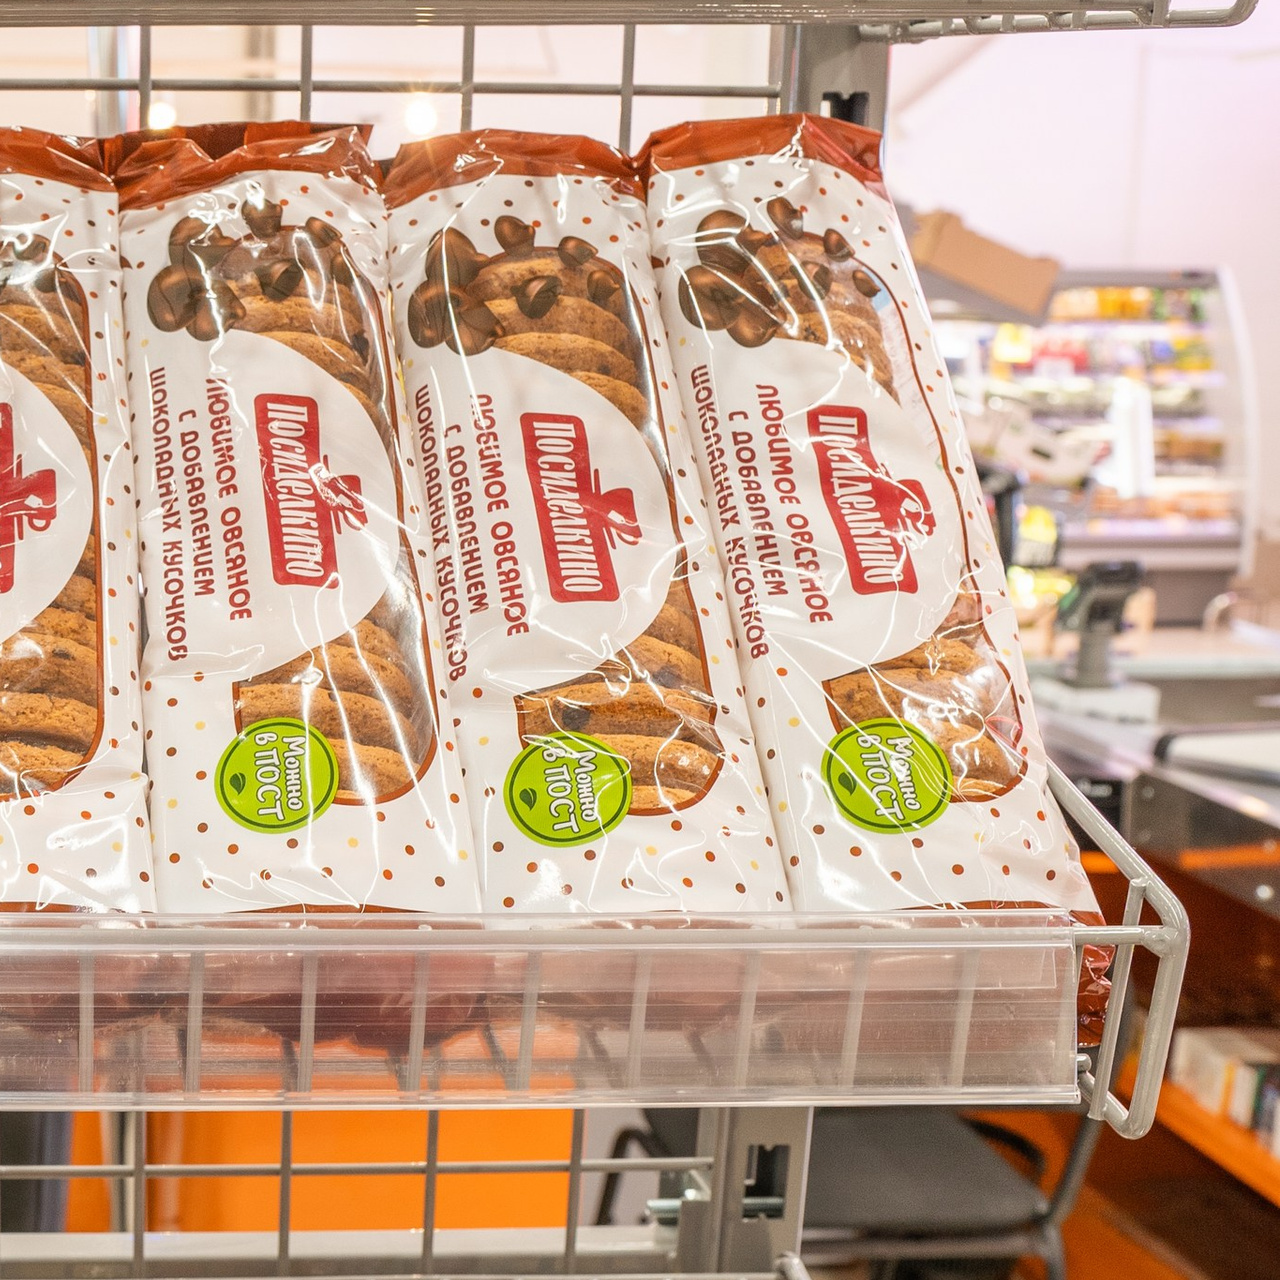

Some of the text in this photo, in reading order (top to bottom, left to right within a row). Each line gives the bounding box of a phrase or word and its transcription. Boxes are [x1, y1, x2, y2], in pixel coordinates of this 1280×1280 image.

[147, 366, 189, 662] ШОКОЛАДНЫХ КУСОЧКОВ
[178, 408, 216, 597] С ДОБАВЛЕНИЕМ
[206, 377, 252, 622] ЛЮБИМОЕ ОВСЯНОЕ
[266, 401, 325, 579] ПОСИДЕЛКИНО
[414, 383, 468, 683] ШОКОЛАДНЫХ КУСОЧКОВ
[443, 424, 490, 615] С ДОБАВЛЕНИЕМ
[468, 393, 531, 638] ЛЮБИМОЕ ОВСЯНОЕ
[531, 419, 604, 594] ПОСИДЕЛКИНО
[690, 364, 770, 661] ШОКОЛАДНЫХ КУСОЧКОВ
[728, 410, 790, 598] С ДОБАВЛЕНИЕМ
[756, 383, 835, 625] ЛЮБИМОЕ ОВСЯНОЕ
[817, 413, 905, 586] ПОСИДЕЛКИНО
[253, 732, 286, 822] в ПОСТ
[280, 735, 306, 812] Можно
[542, 746, 581, 836] в ПОСТ
[575, 748, 600, 823] Можно
[856, 732, 906, 823] в ПОСТ
[886, 734, 922, 812] Можно
